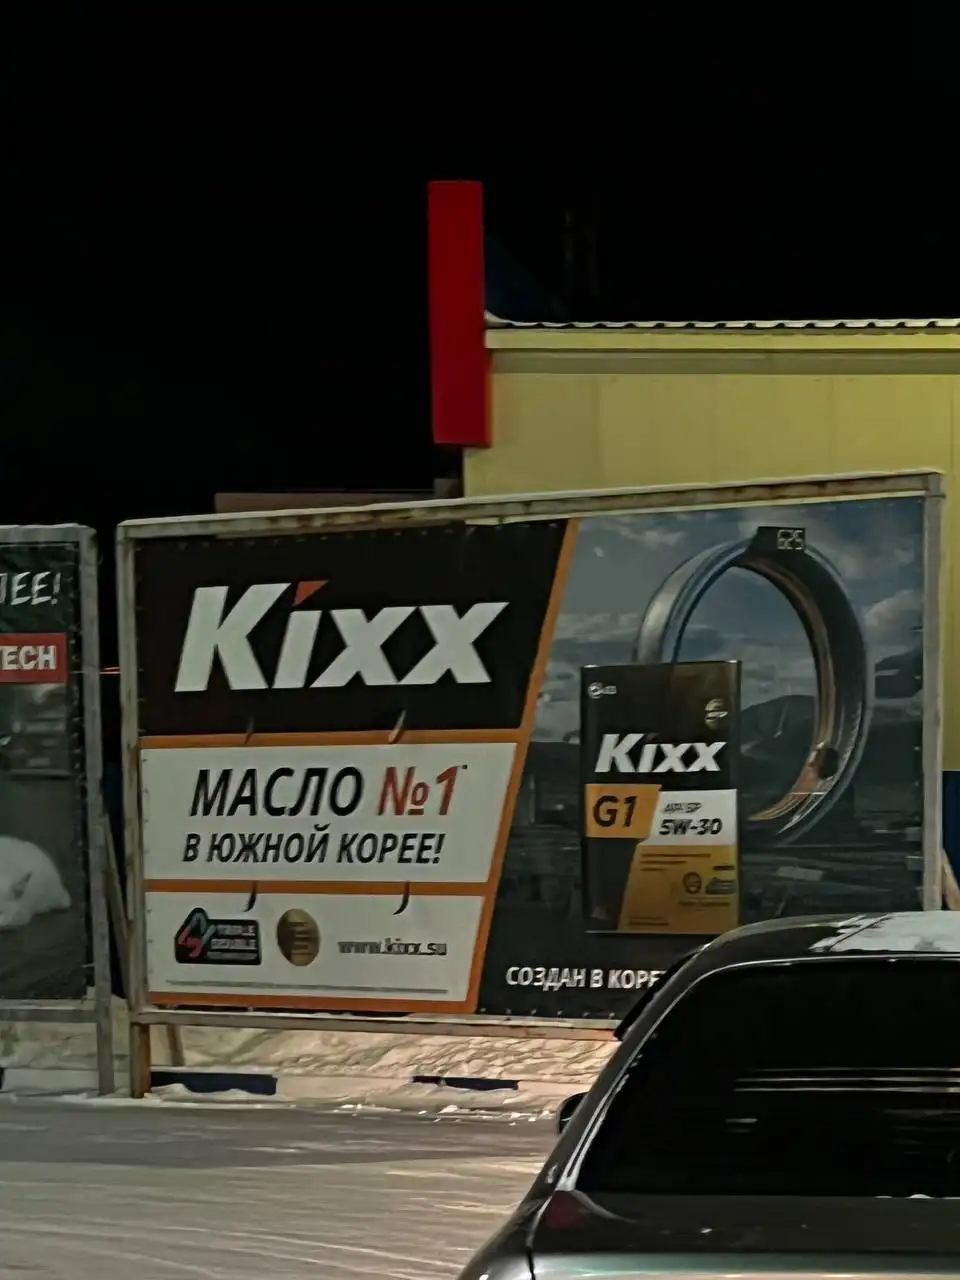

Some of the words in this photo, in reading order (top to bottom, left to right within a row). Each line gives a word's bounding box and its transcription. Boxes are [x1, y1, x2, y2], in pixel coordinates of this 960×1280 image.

[174, 580, 510, 692] Kixx
[0, 645, 57, 670] ECH
[594, 733, 728, 773] Kixx
[189, 767, 365, 817] МАСЛО
[592, 795, 638, 828] G1
[659, 817, 723, 836] 5W-30
[182, 833, 202, 863] В
[206, 823, 330, 863] ЮЖНОЙ
[336, 832, 446, 864] КОРЕЕ!
[505, 966, 587, 992] СОЗДАН
[589, 969, 604, 988] В
